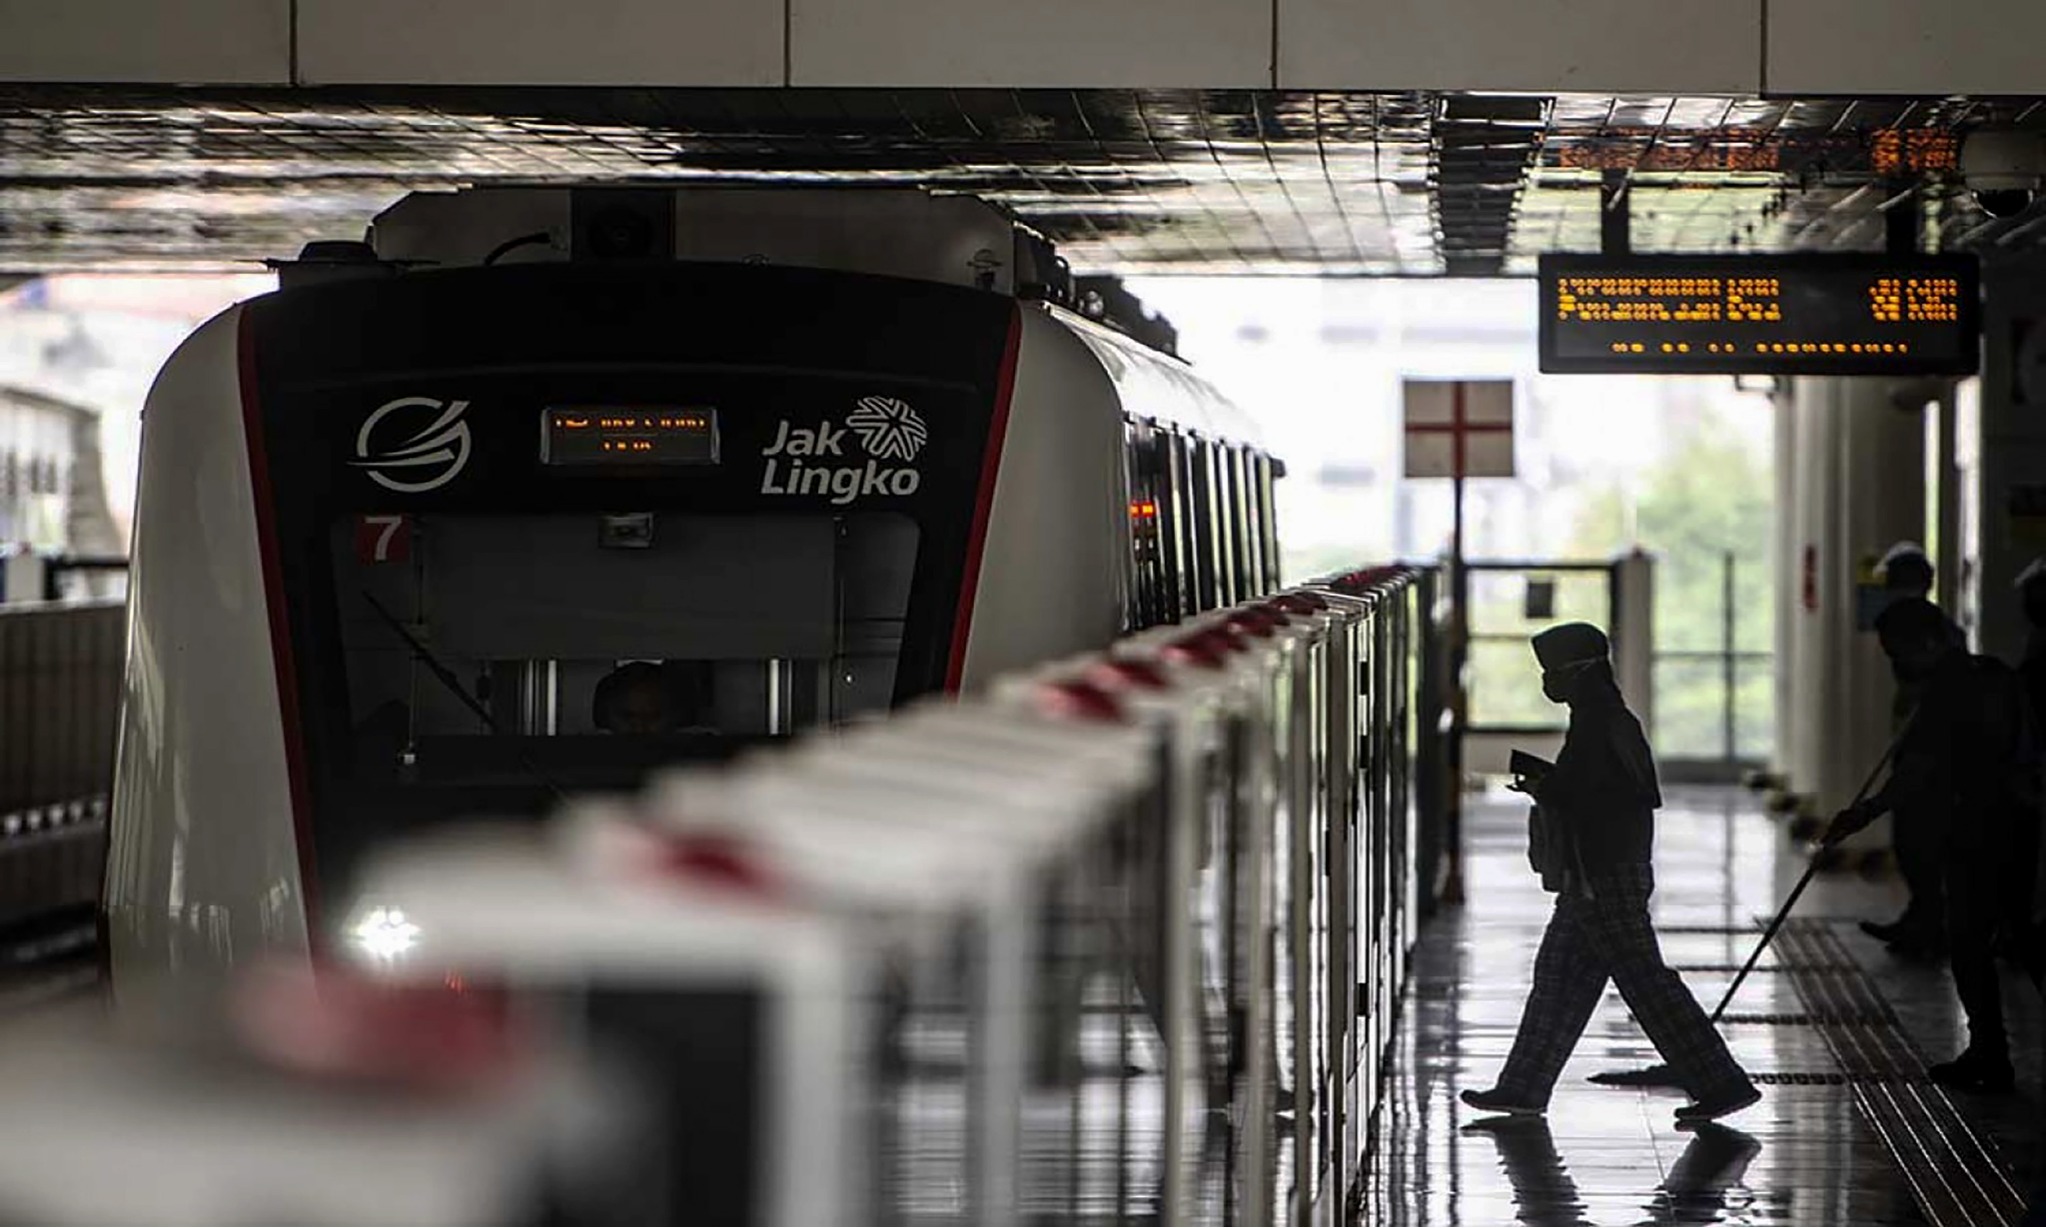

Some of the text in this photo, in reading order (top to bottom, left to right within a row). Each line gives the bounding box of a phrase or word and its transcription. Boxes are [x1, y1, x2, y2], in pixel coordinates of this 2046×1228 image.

[762, 420, 846, 456] Jak
[761, 458, 920, 505] Lingko
[365, 515, 402, 561] 7
